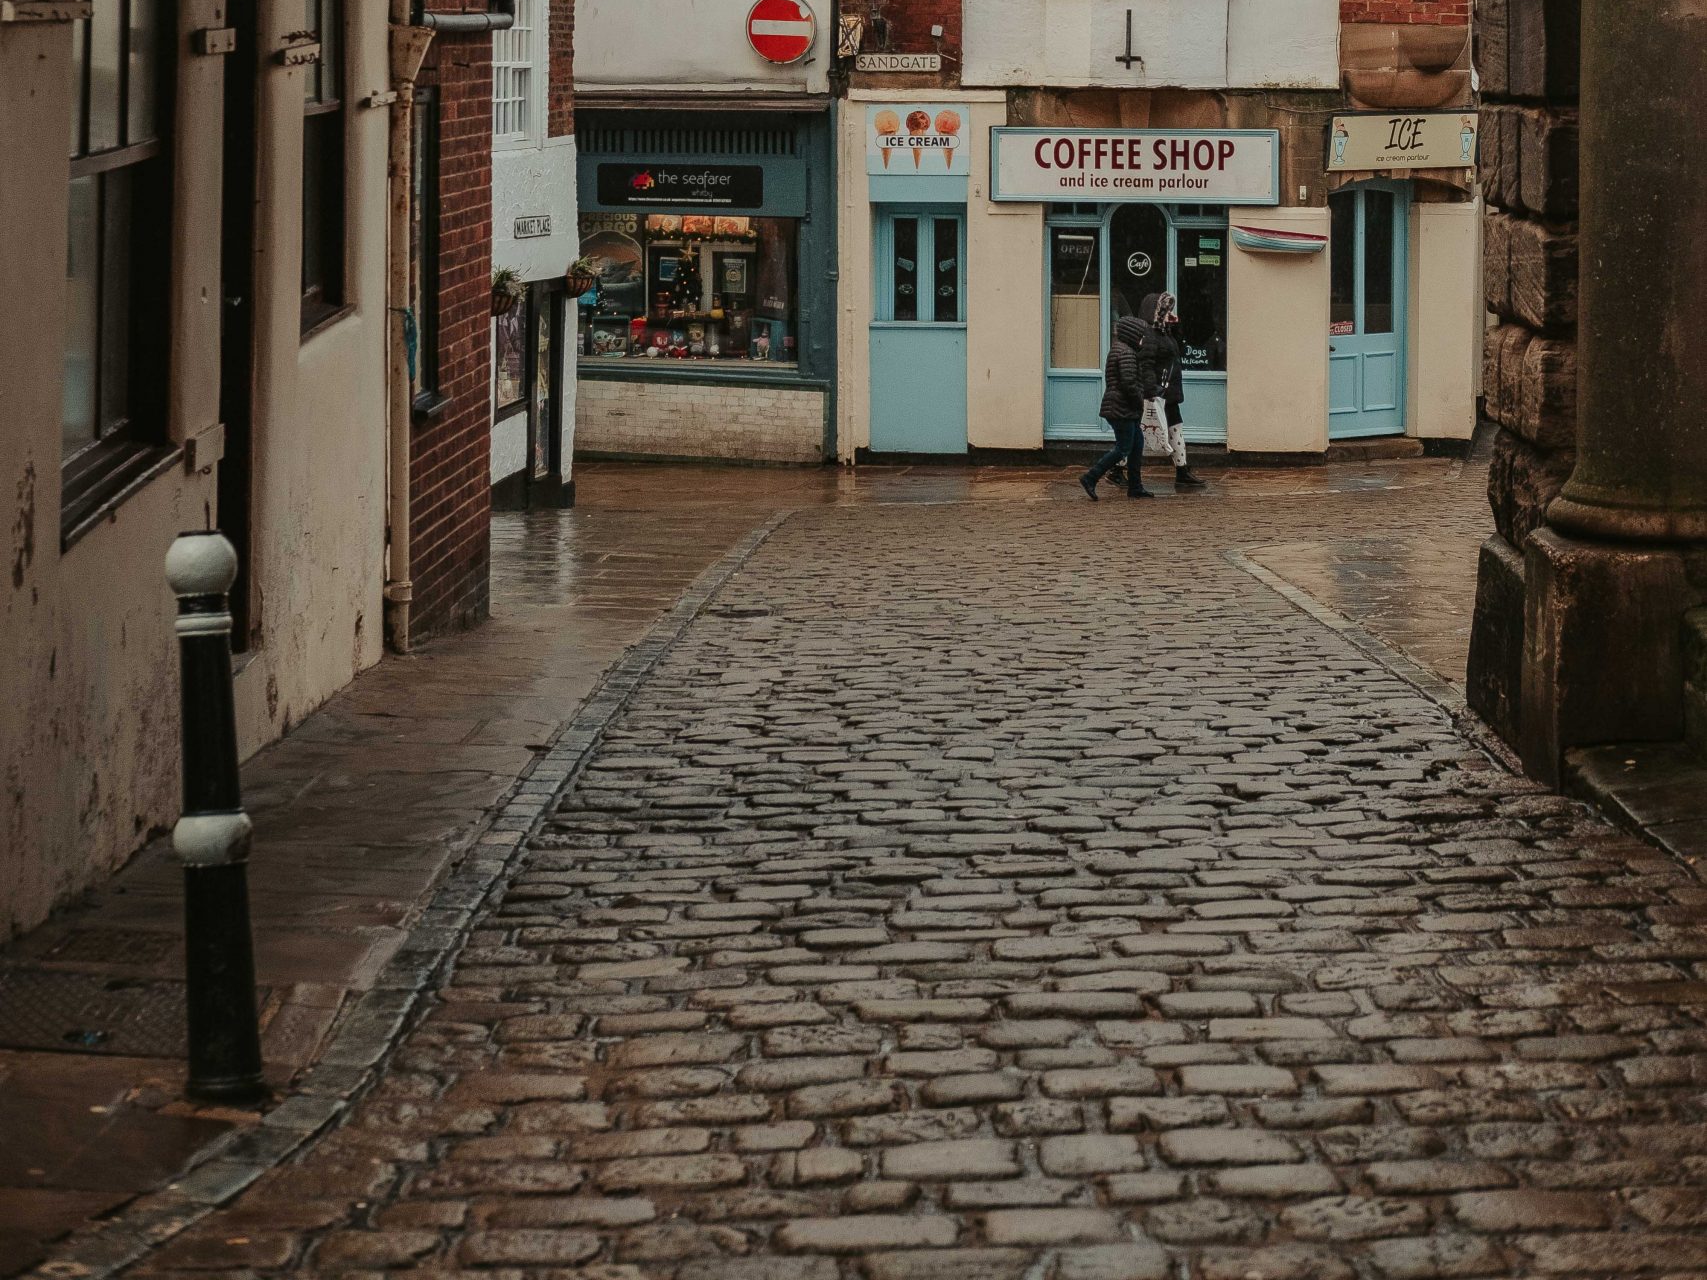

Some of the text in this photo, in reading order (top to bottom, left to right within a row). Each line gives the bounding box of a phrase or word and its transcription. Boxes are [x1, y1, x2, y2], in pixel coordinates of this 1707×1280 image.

[859, 56, 937, 69] SANDGATE
[1384, 118, 1427, 150] ICE
[886, 137, 950, 147] ICE CREAM
[1034, 137, 1235, 171] COFFEE SHOP
[1406, 153, 1430, 163] parlour
[658, 170, 732, 189] the seafarer
[1059, 172, 1209, 192] and ice cream parlour
[516, 218, 551, 235] MARKET PLACE
[581, 221, 638, 233] CARGO
[1060, 243, 1091, 254] OPEN
[1334, 324, 1353, 333] CLOSED
[1185, 345, 1207, 359] Dogs
[1181, 357, 1209, 365] Welcome
